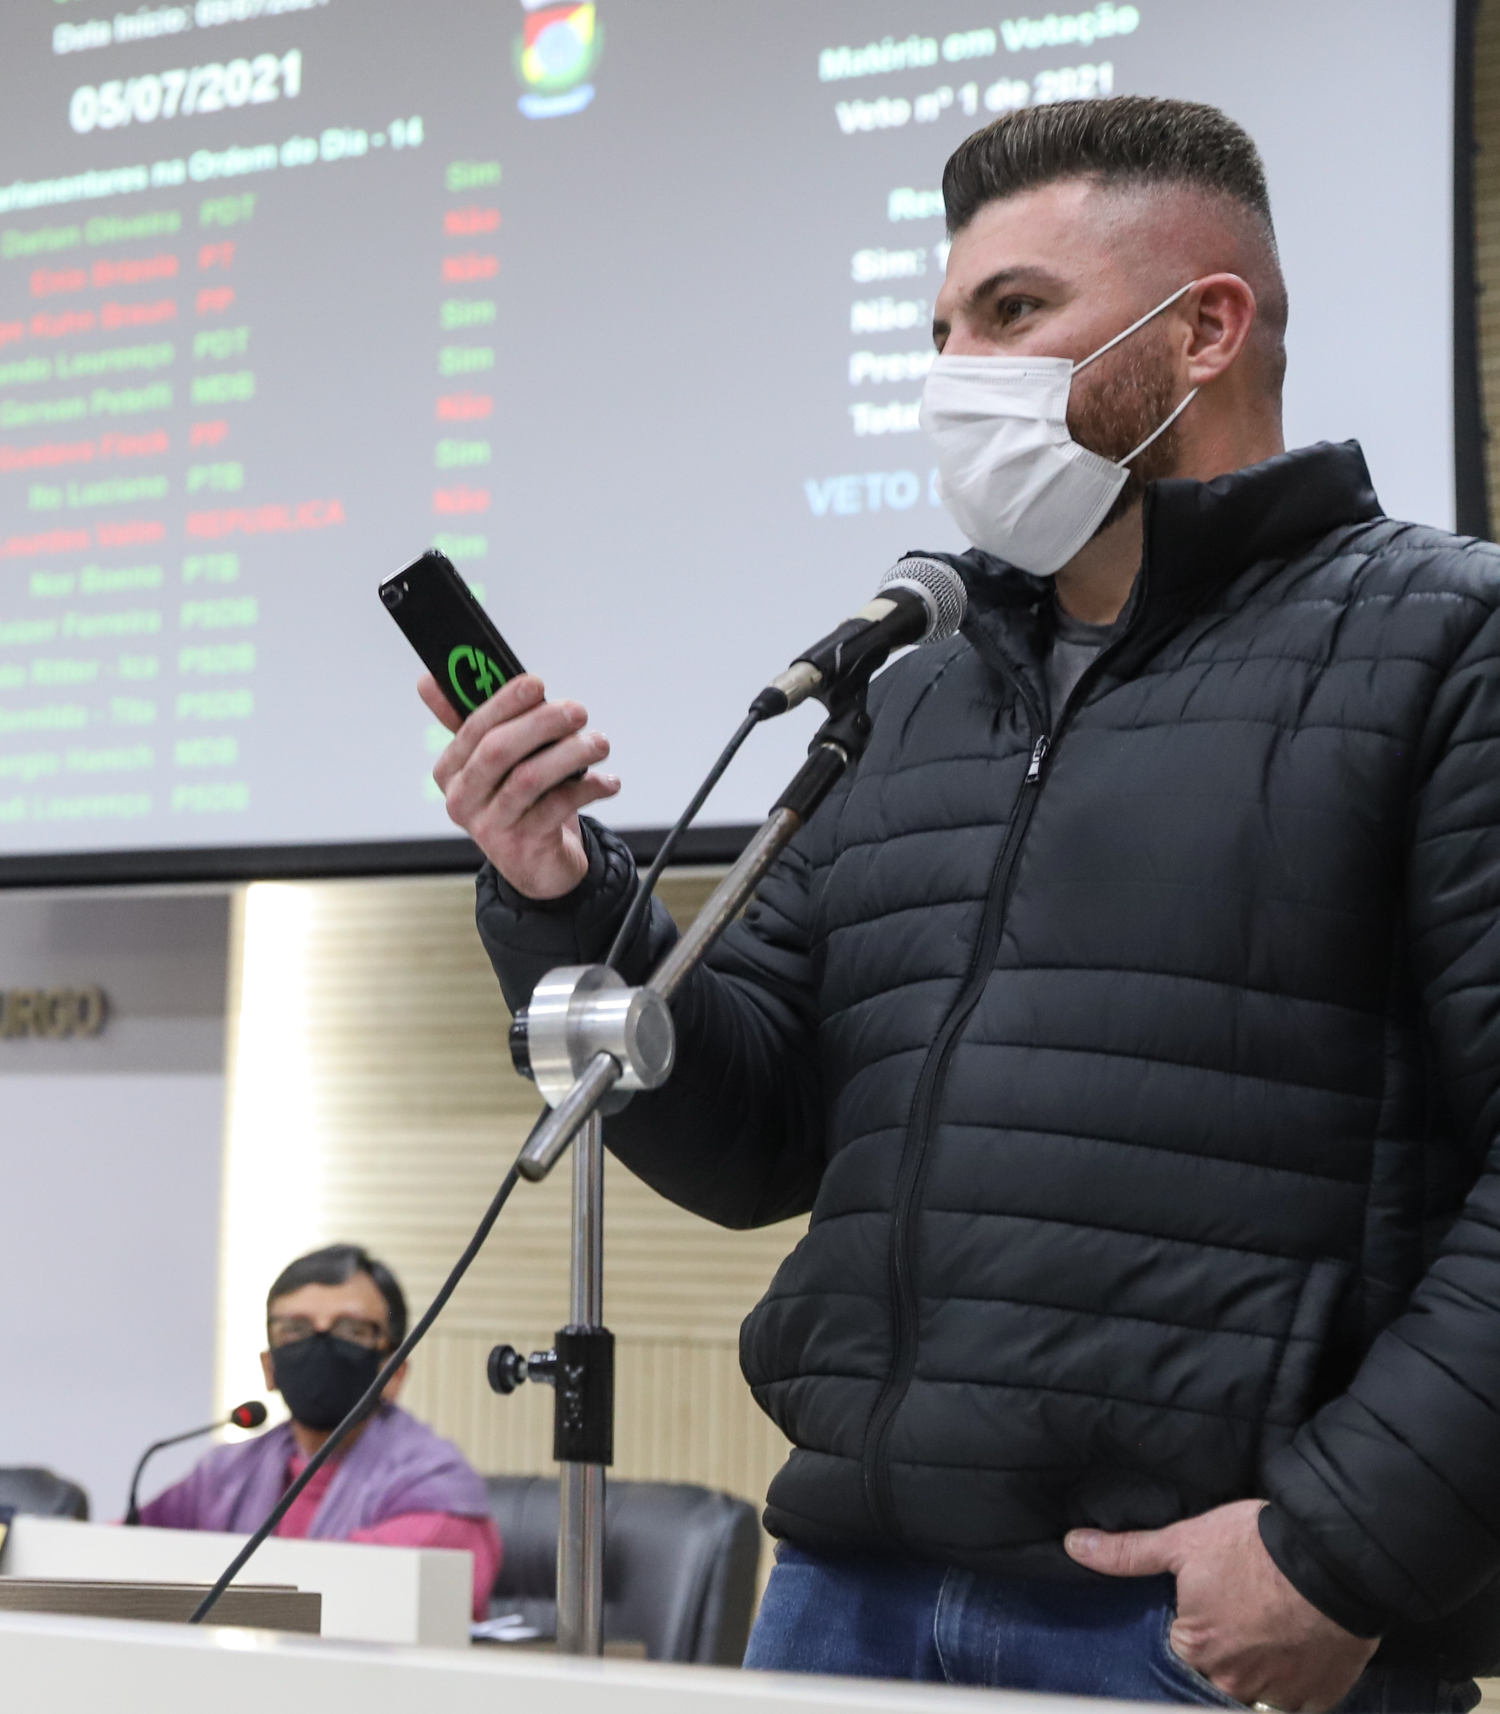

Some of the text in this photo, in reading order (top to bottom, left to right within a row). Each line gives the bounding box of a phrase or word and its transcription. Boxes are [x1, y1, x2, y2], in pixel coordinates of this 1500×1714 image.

[818, 2, 1140, 82] Matéria em Votação
[69, 49, 303, 134] 05/07/2021
[835, 95, 913, 134] Veto
[957, 81, 979, 117] 1
[984, 76, 1031, 112] de
[1033, 61, 1114, 105] 2021
[188, 142, 278, 183] Ordem
[320, 126, 369, 162] Dia
[446, 161, 502, 192] Sim
[442, 204, 503, 237] Não
[440, 250, 500, 284] Não
[851, 248, 928, 282] Sim:
[440, 299, 497, 330] Sim
[850, 295, 928, 334] Não:
[438, 346, 495, 376] Sim
[434, 390, 495, 422] Não
[435, 438, 492, 470] Sim
[431, 484, 492, 516] Não
[804, 469, 921, 517] VETO
